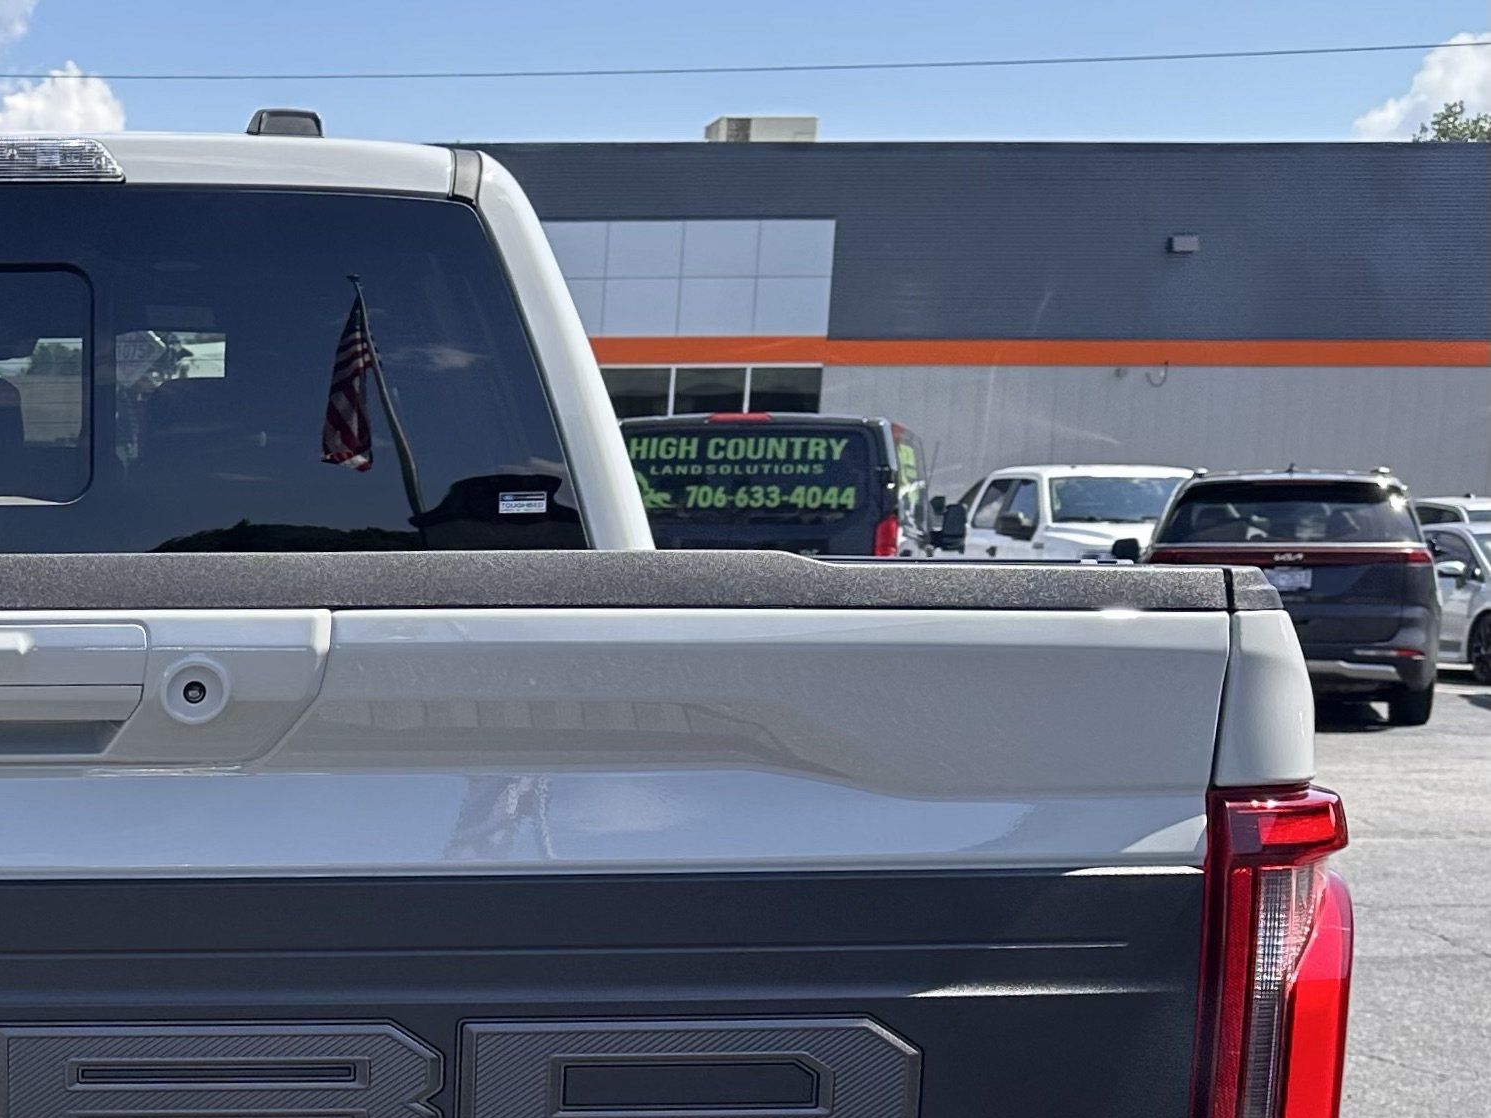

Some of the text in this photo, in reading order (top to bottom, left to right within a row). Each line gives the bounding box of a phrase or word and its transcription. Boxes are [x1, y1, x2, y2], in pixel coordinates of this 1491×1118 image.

[629, 437, 848, 461] HIGH COUNTRY
[685, 486, 856, 509] 706-633-4044
